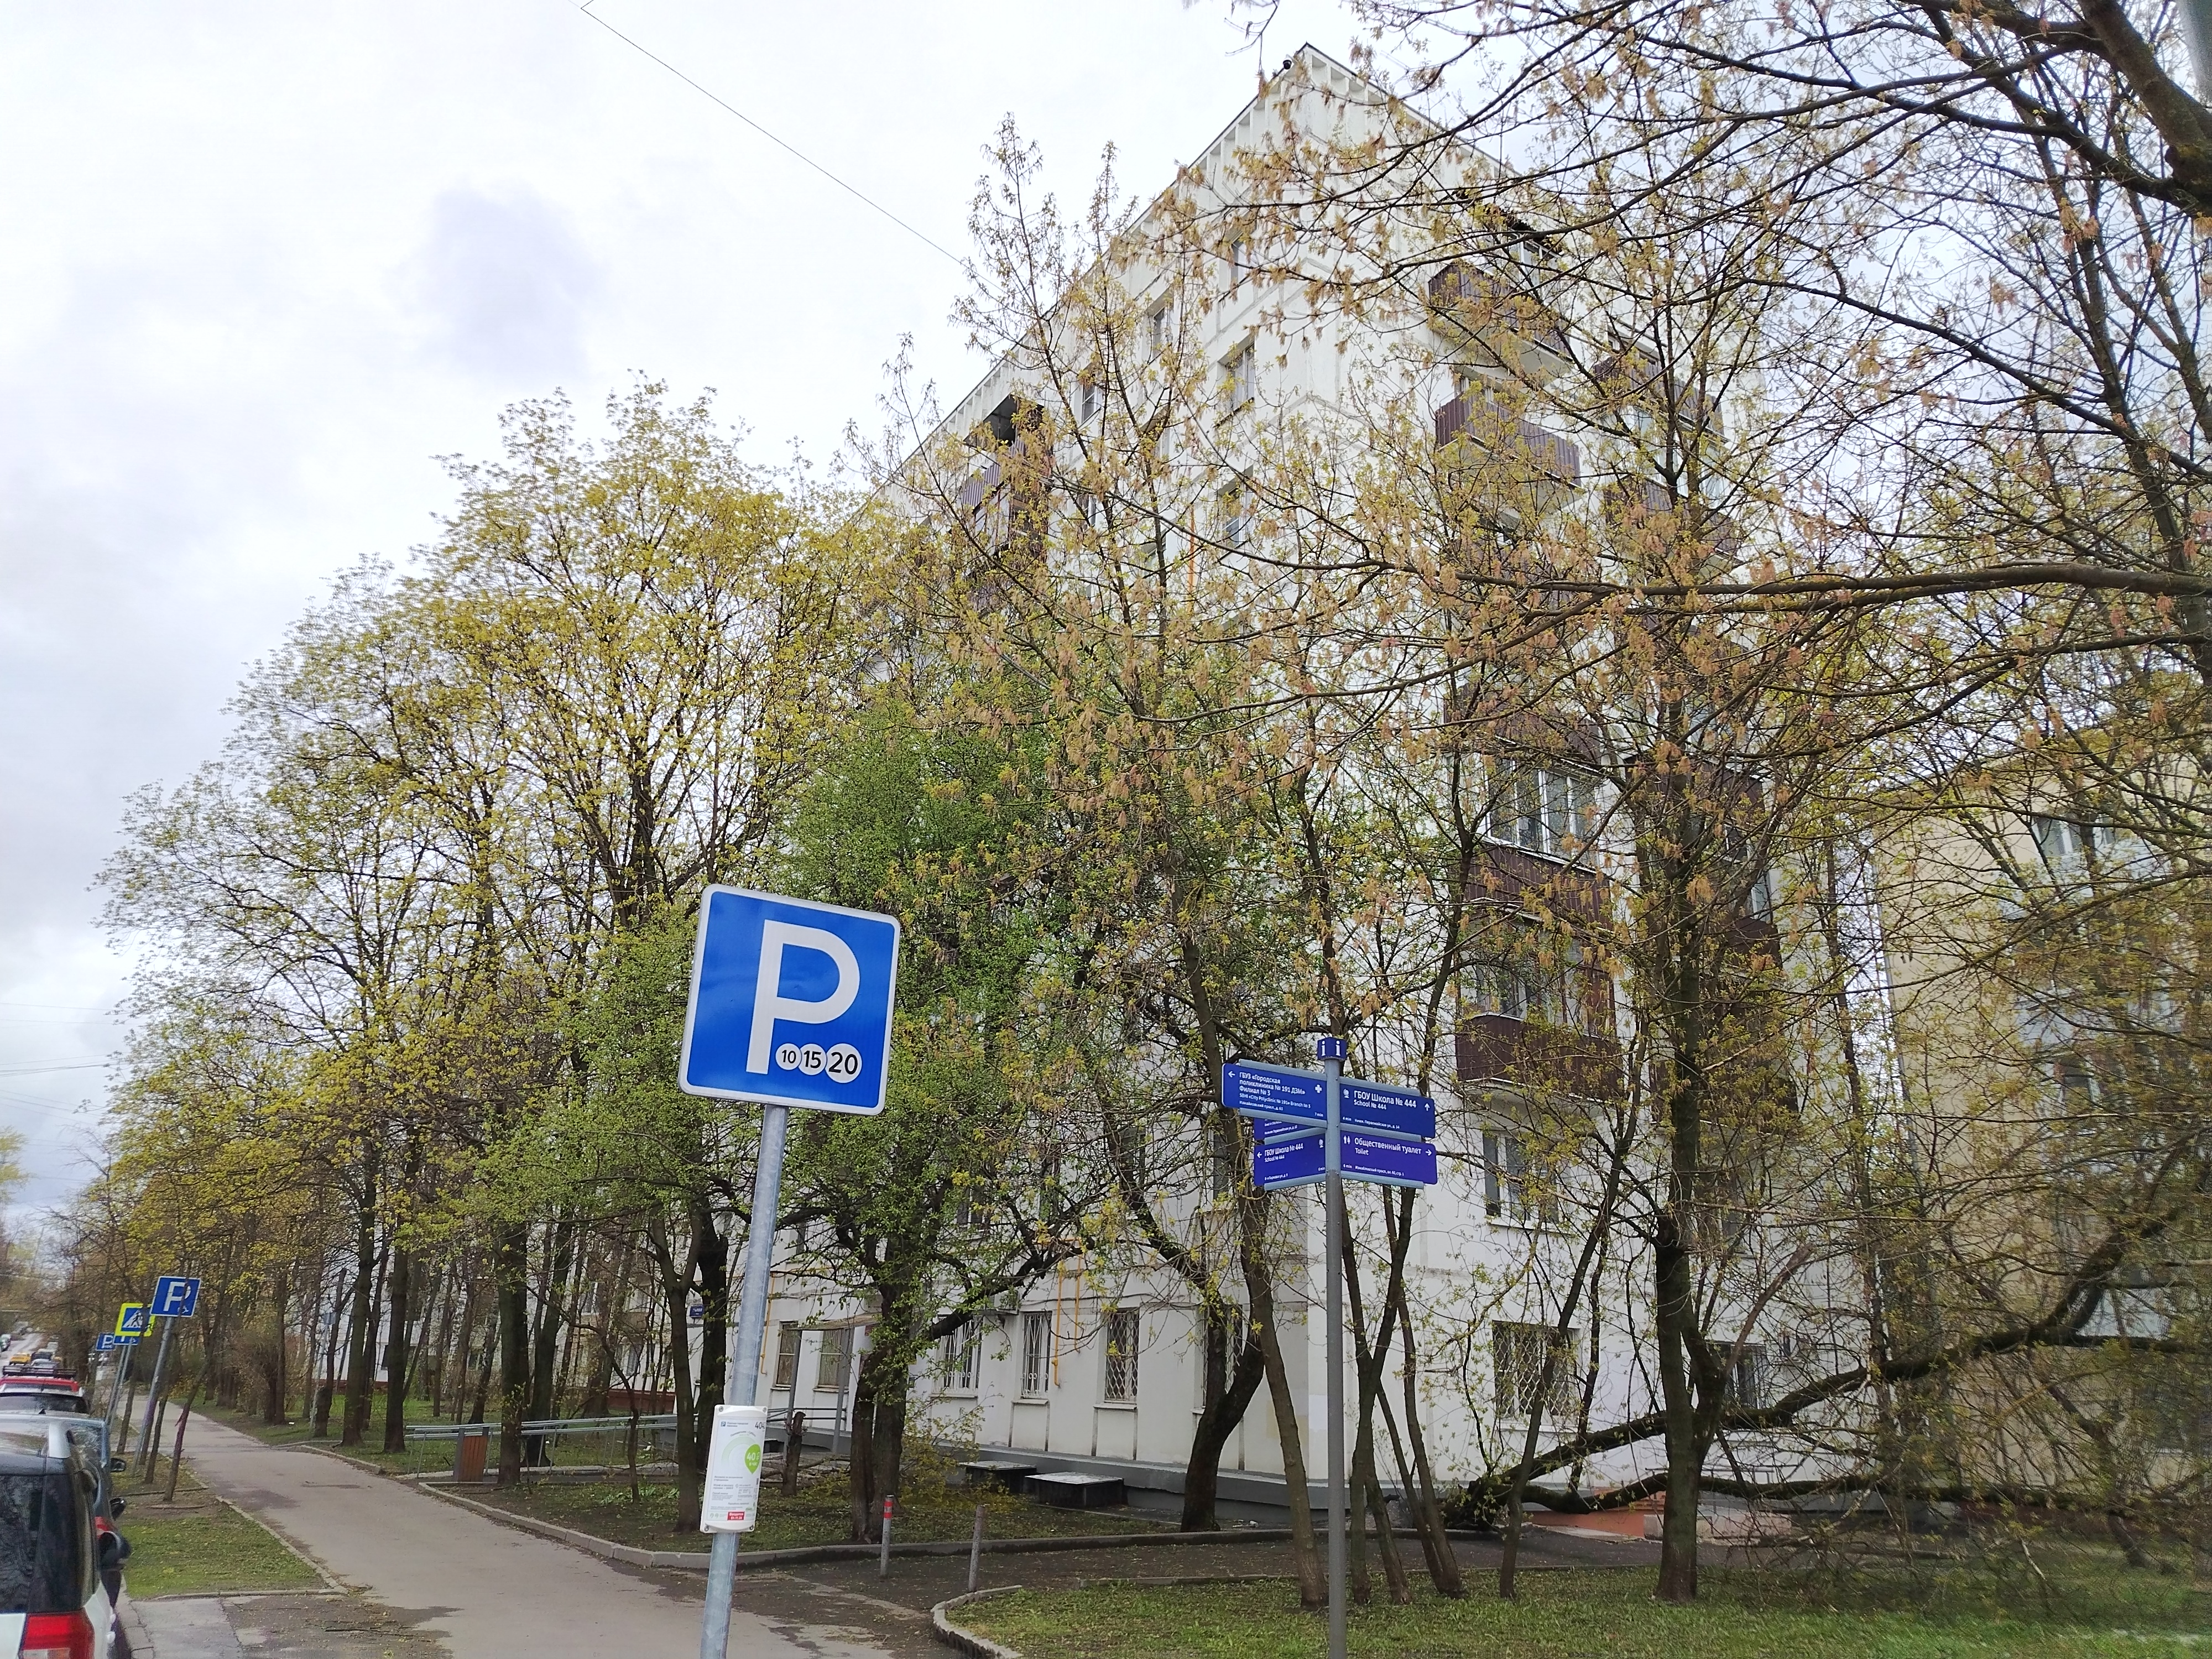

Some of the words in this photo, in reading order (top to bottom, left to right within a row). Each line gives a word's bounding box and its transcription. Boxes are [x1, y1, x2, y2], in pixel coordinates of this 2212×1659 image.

[746, 919, 860, 1074] P
[781, 1049, 797, 1065] 10
[803, 1051, 822, 1069] 15
[828, 1052, 858, 1074] 20
[1239, 1079, 1274, 1090] поликлиника
[1251, 1074, 1281, 1084] «Городская
[1239, 1085, 1260, 1094] Филиал
[1354, 1090, 1370, 1100] ГБОУ
[1371, 1093, 1394, 1104] Школа
[1395, 1097, 1404, 1106] №
[1404, 1099, 1417, 1108] 444
[1264, 1148, 1275, 1156] ГБОУ
[1275, 1146, 1289, 1155] Школа
[1354, 1138, 1401, 1151] Общественный
[1402, 1146, 1422, 1154] туалет
[163, 1281, 191, 1312] P
[747, 1452, 756, 1461] 40
